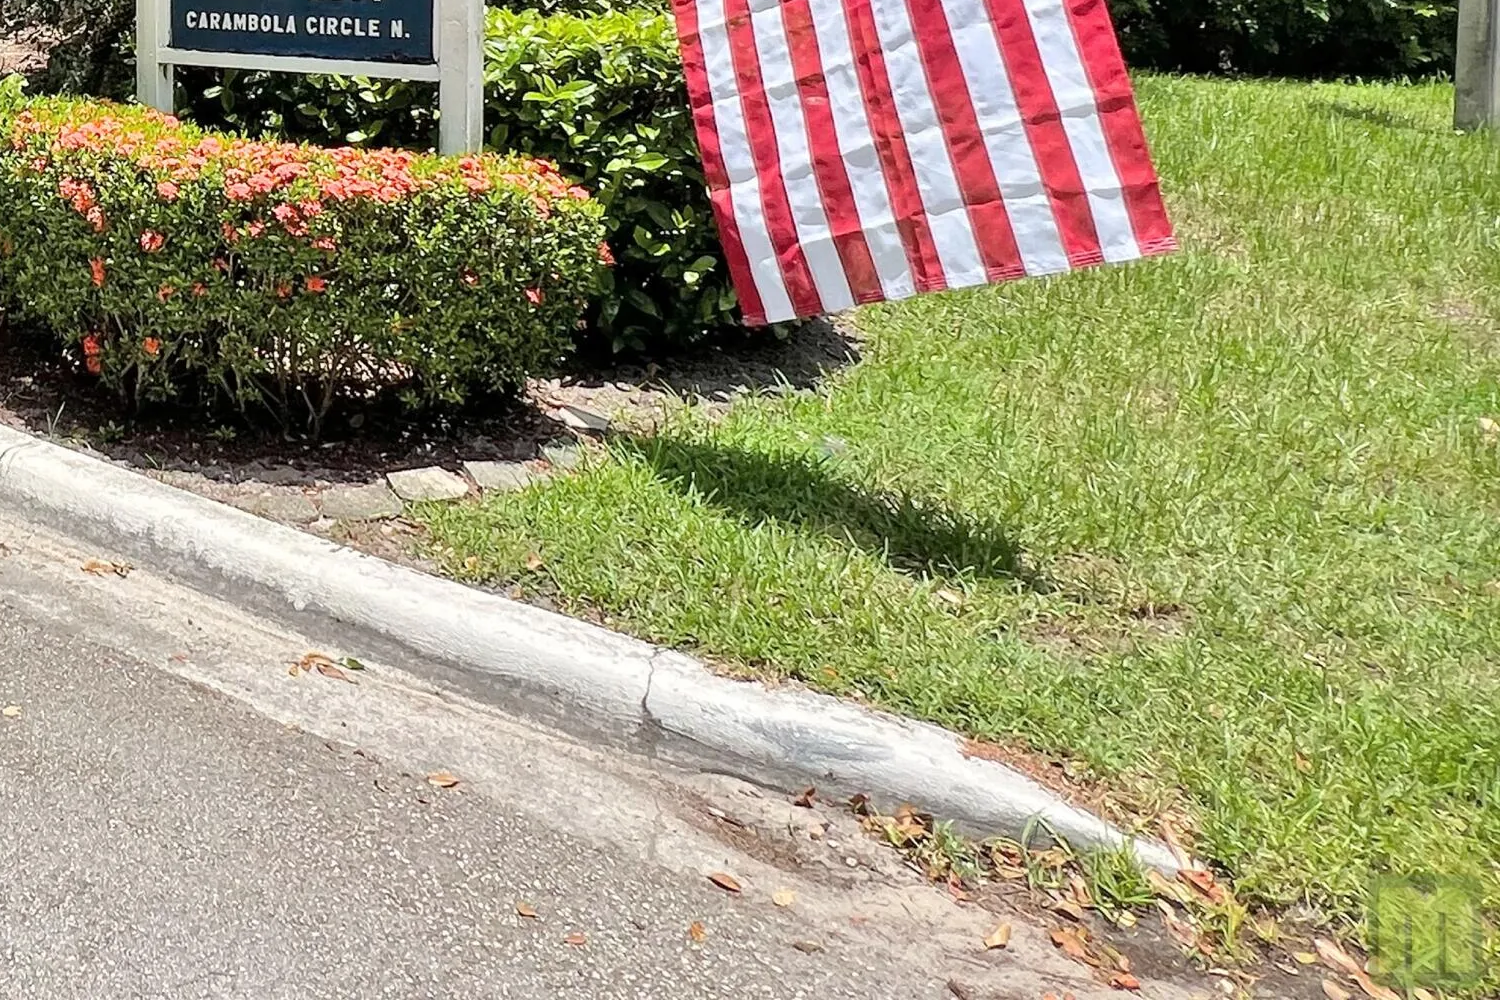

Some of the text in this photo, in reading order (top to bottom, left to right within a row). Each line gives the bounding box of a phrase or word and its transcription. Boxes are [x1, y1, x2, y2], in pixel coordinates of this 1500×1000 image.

[186, 11, 410, 39] CARAMBOLA CIRCLE N.
